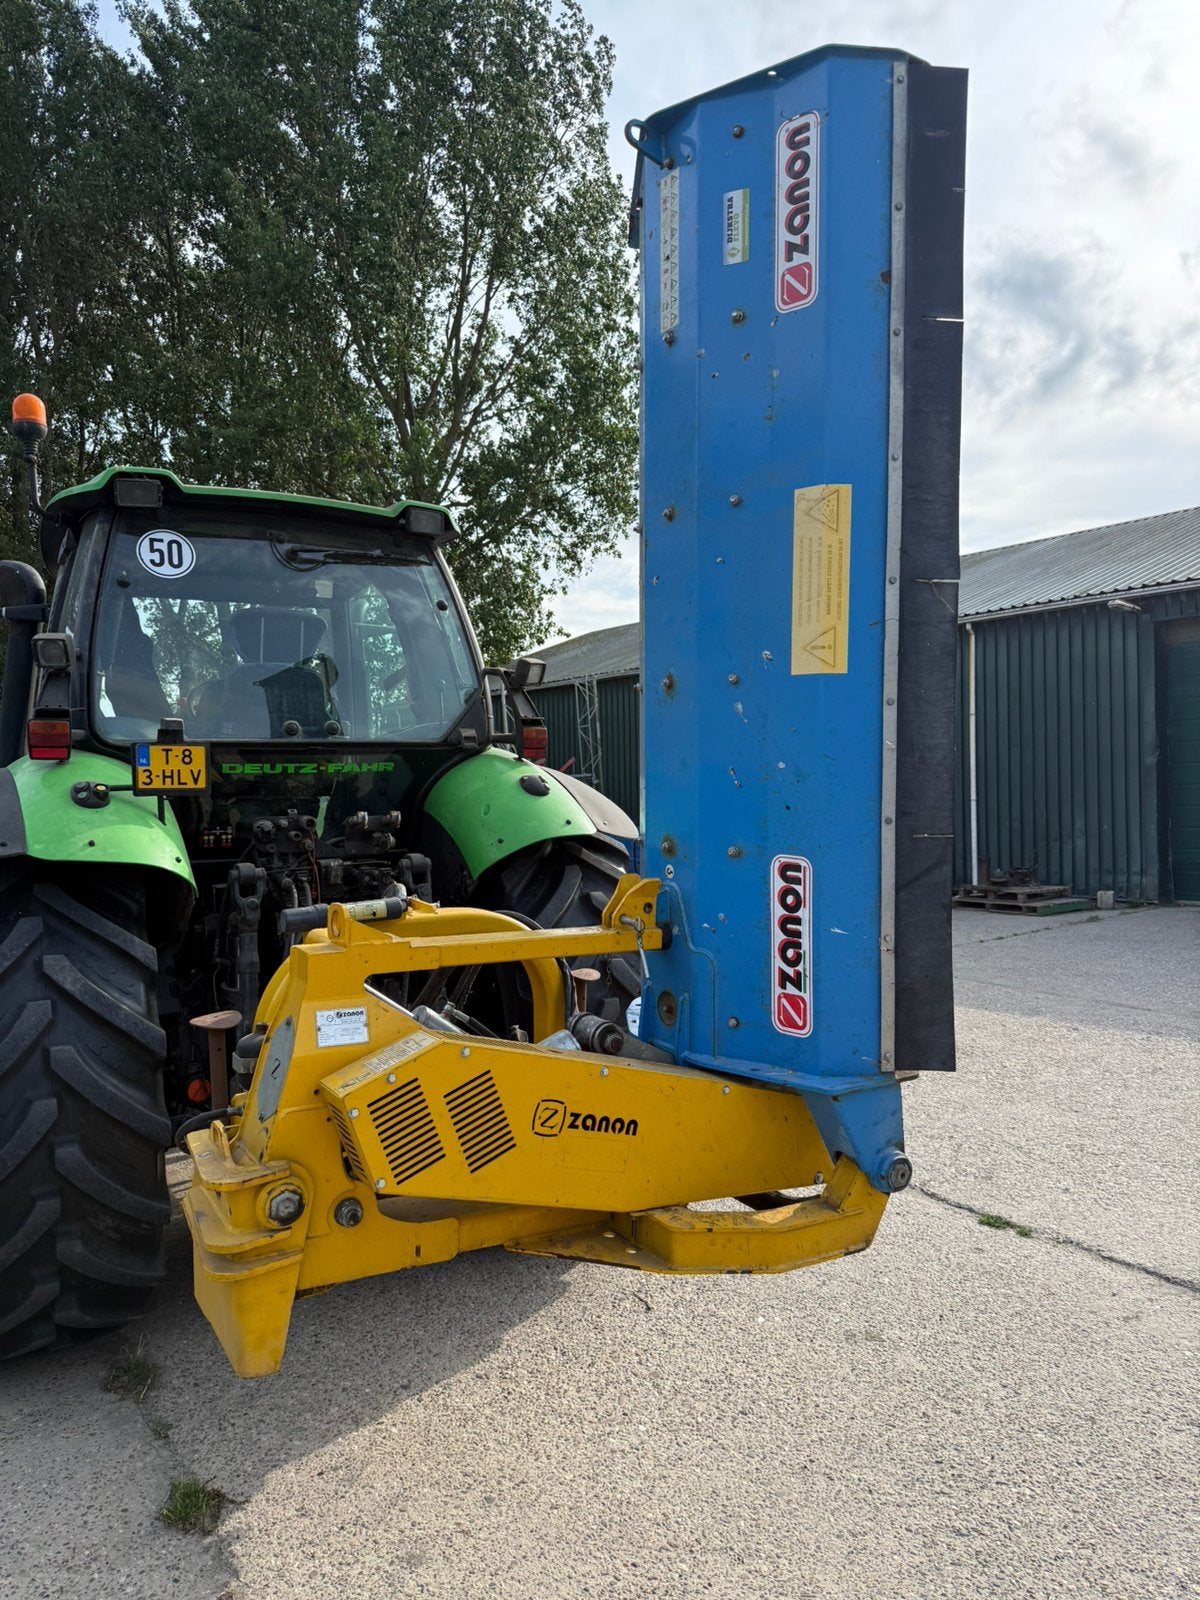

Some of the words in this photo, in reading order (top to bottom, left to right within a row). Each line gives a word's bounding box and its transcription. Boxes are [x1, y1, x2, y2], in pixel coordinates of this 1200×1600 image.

[785, 121, 811, 263] zanon
[726, 196, 734, 244] DIJKSTRA
[148, 537, 184, 569] 50
[161, 748, 193, 765] T-8
[222, 761, 395, 775] DEUTZ-FAHR
[142, 768, 202, 786] 3-HLV
[778, 861, 803, 993] zanon
[567, 1112, 639, 1137] zanon
